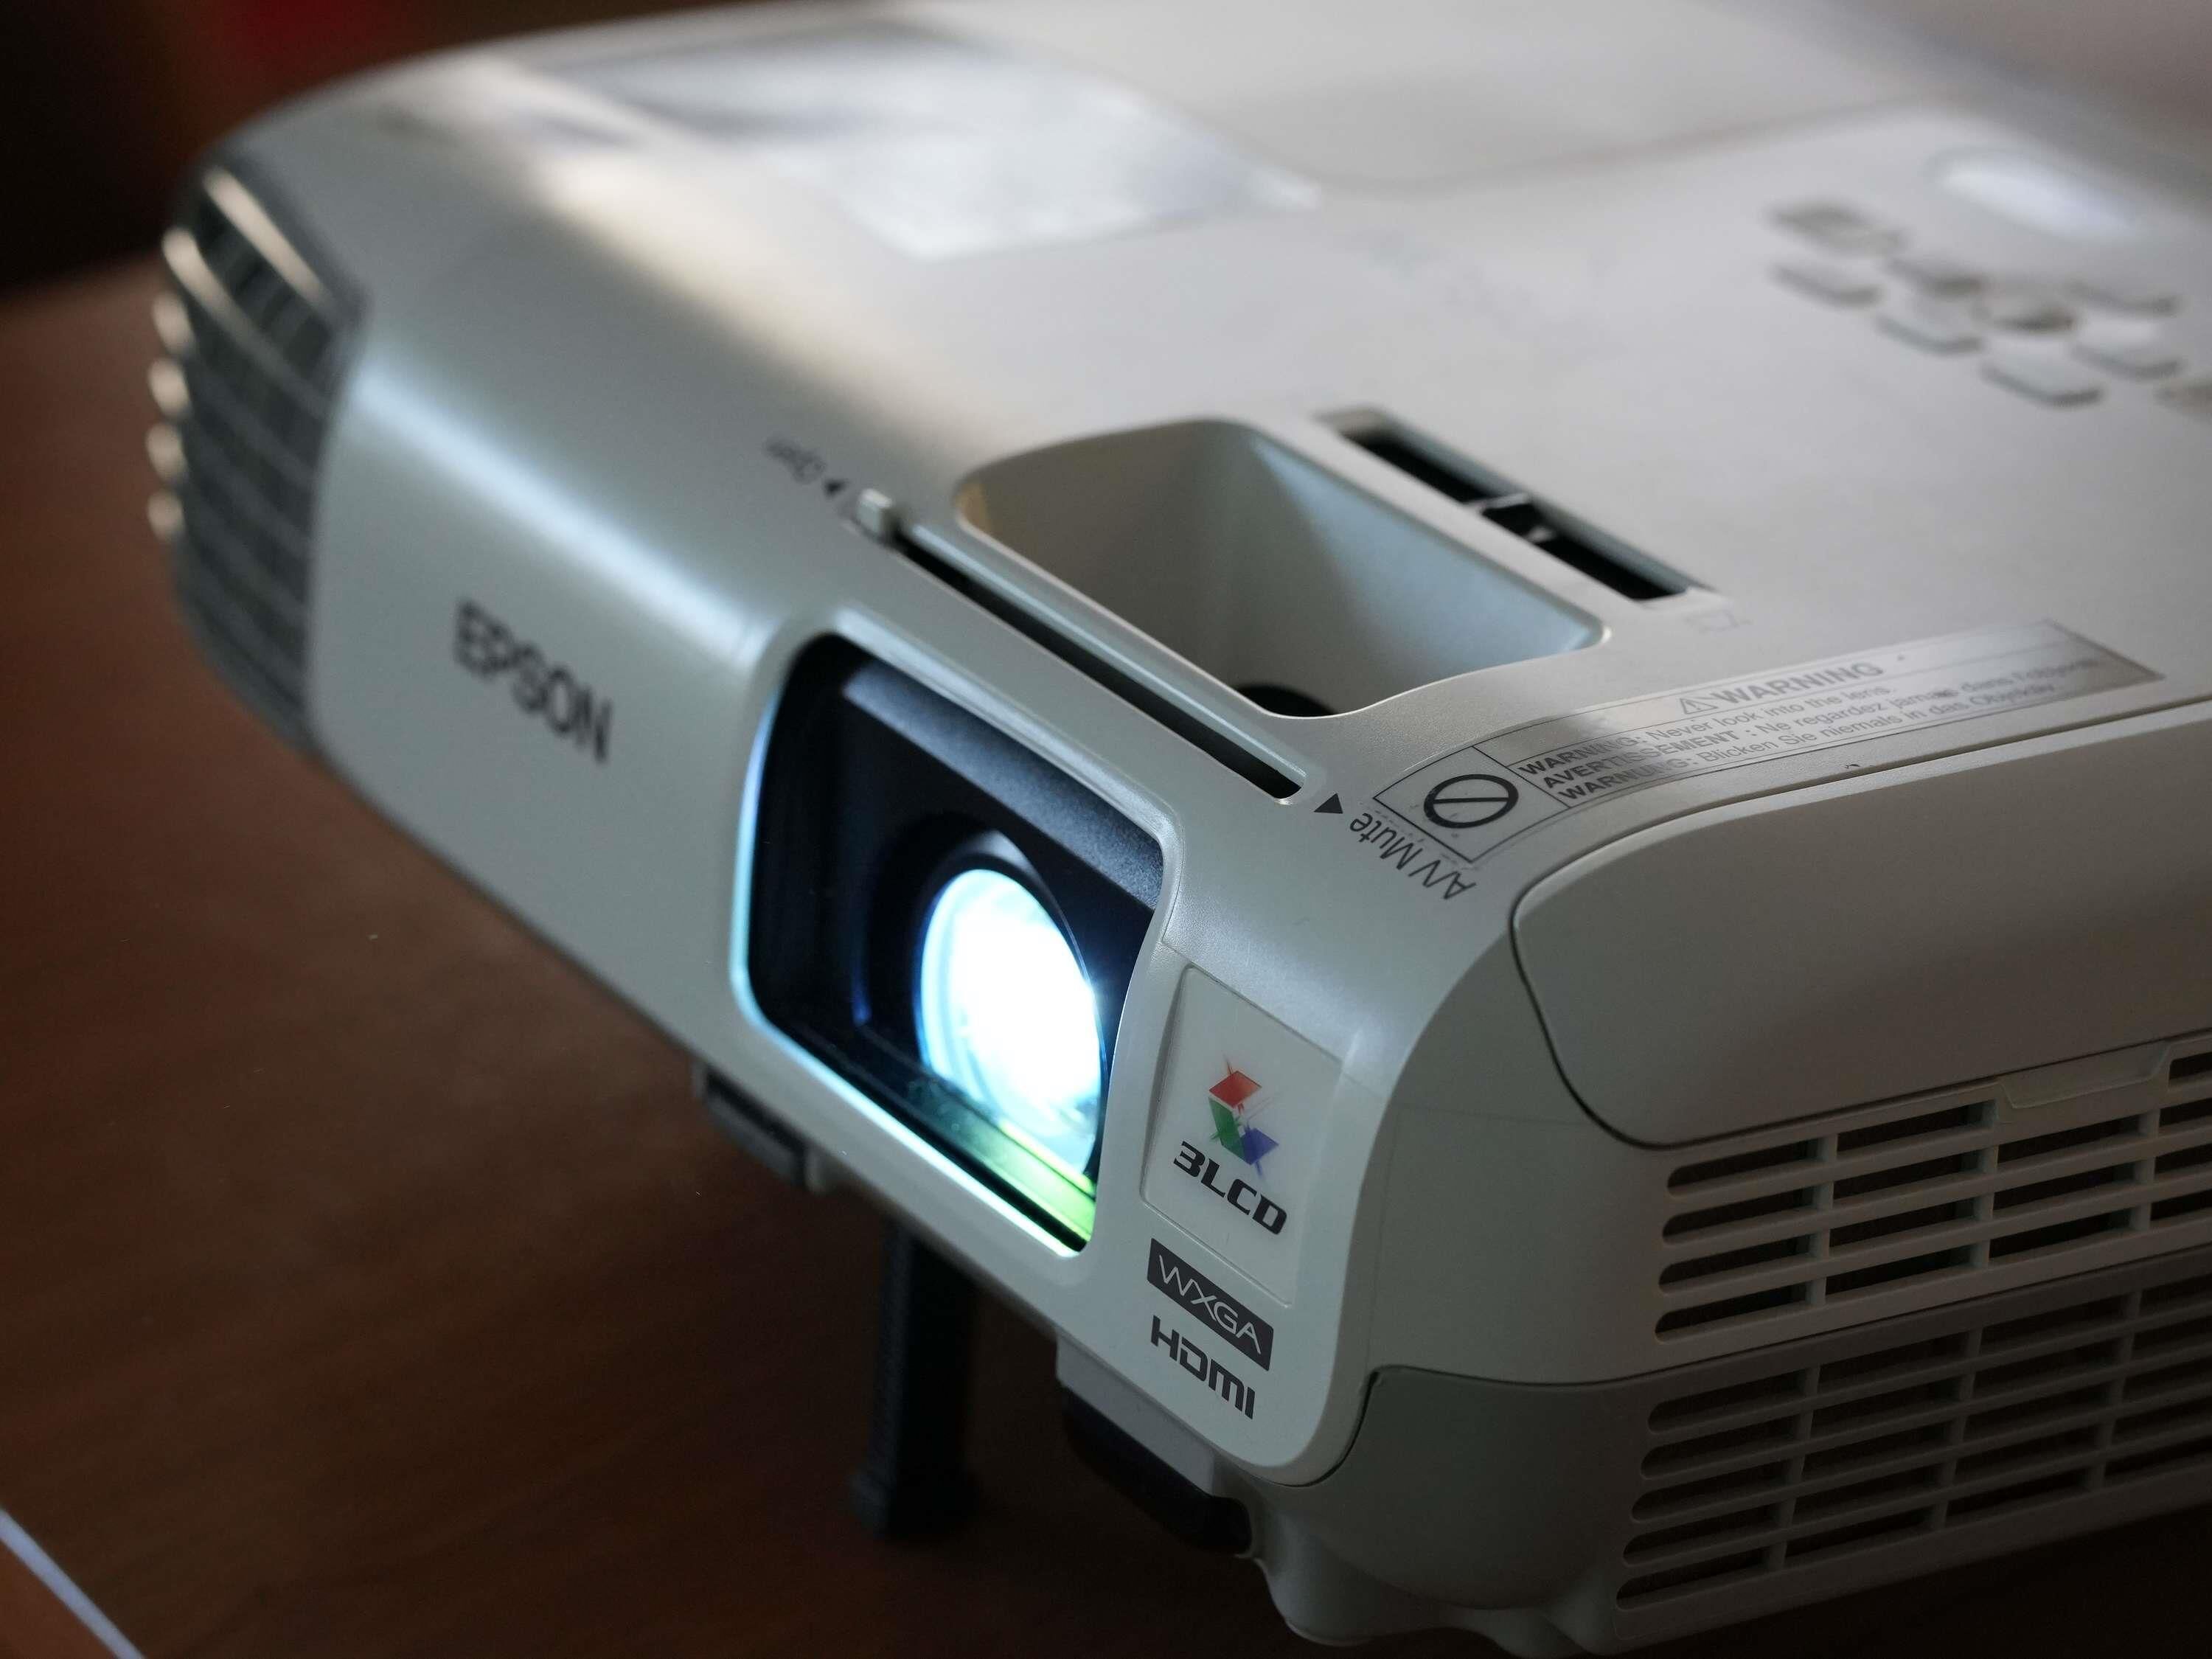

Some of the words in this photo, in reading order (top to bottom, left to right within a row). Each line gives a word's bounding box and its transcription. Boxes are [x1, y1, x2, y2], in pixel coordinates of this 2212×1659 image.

[453, 598, 613, 764] EPSON
[1711, 663, 1884, 703] WARNING
[1518, 736, 1647, 775] WARNING:
[1646, 721, 1714, 740] Never
[1713, 712, 1764, 726] look
[1761, 702, 1804, 716] into
[1804, 695, 1843, 708] the
[1543, 730, 1740, 788] AVERTISSEMENT
[1754, 722, 1792, 736] Ne
[1793, 703, 1889, 727] regardez
[1558, 757, 1699, 799] WARNUNG:
[1697, 738, 1779, 762] Blicken
[1778, 732, 1818, 745] Sie
[1819, 714, 1903, 737] niemals
[1901, 709, 1927, 721] in
[1349, 813, 1423, 869] Mute
[1408, 859, 1477, 900] A/V
[1172, 1141, 1287, 1235] 3LCD
[1159, 1254, 1262, 1354] WXGA
[1151, 1315, 1256, 1420] HDMI
